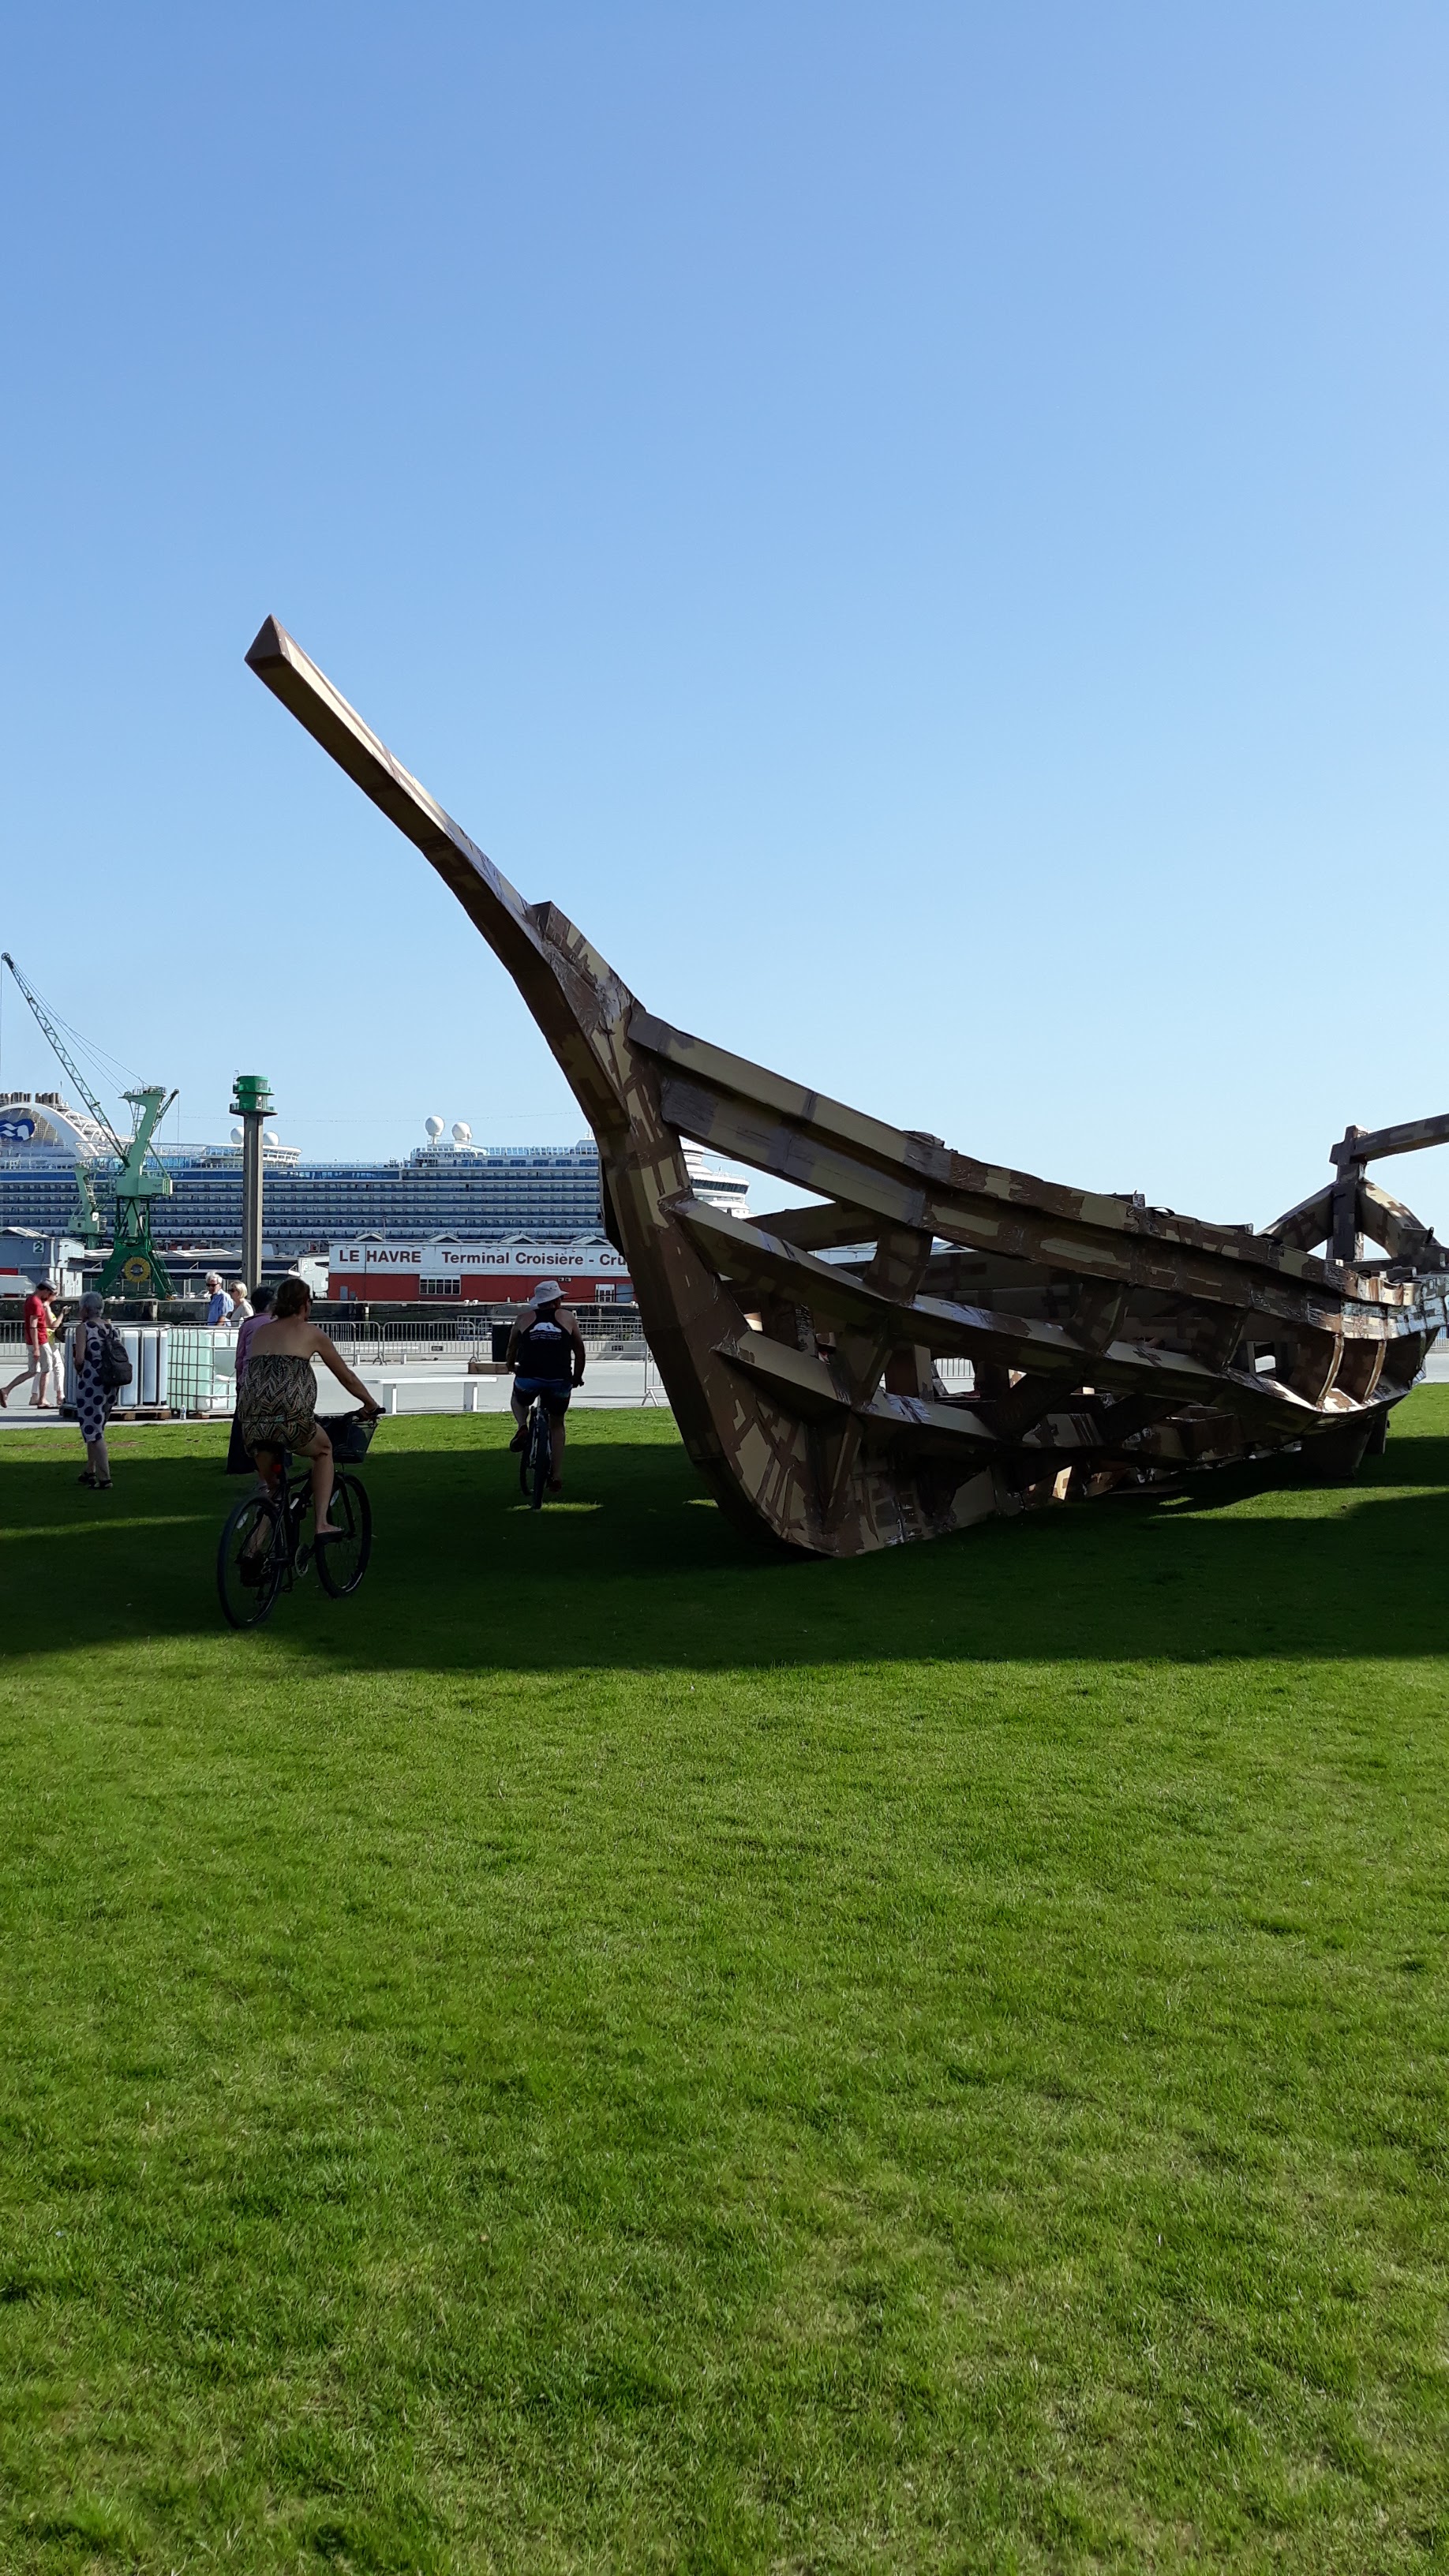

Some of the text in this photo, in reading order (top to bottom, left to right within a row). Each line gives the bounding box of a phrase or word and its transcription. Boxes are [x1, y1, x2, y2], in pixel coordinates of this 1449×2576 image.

[35, 1243, 43, 1252] 2
[339, 1250, 421, 1263] LE HAVRE
[442, 1252, 509, 1264] Terminal
[515, 1252, 584, 1264] Croisière
